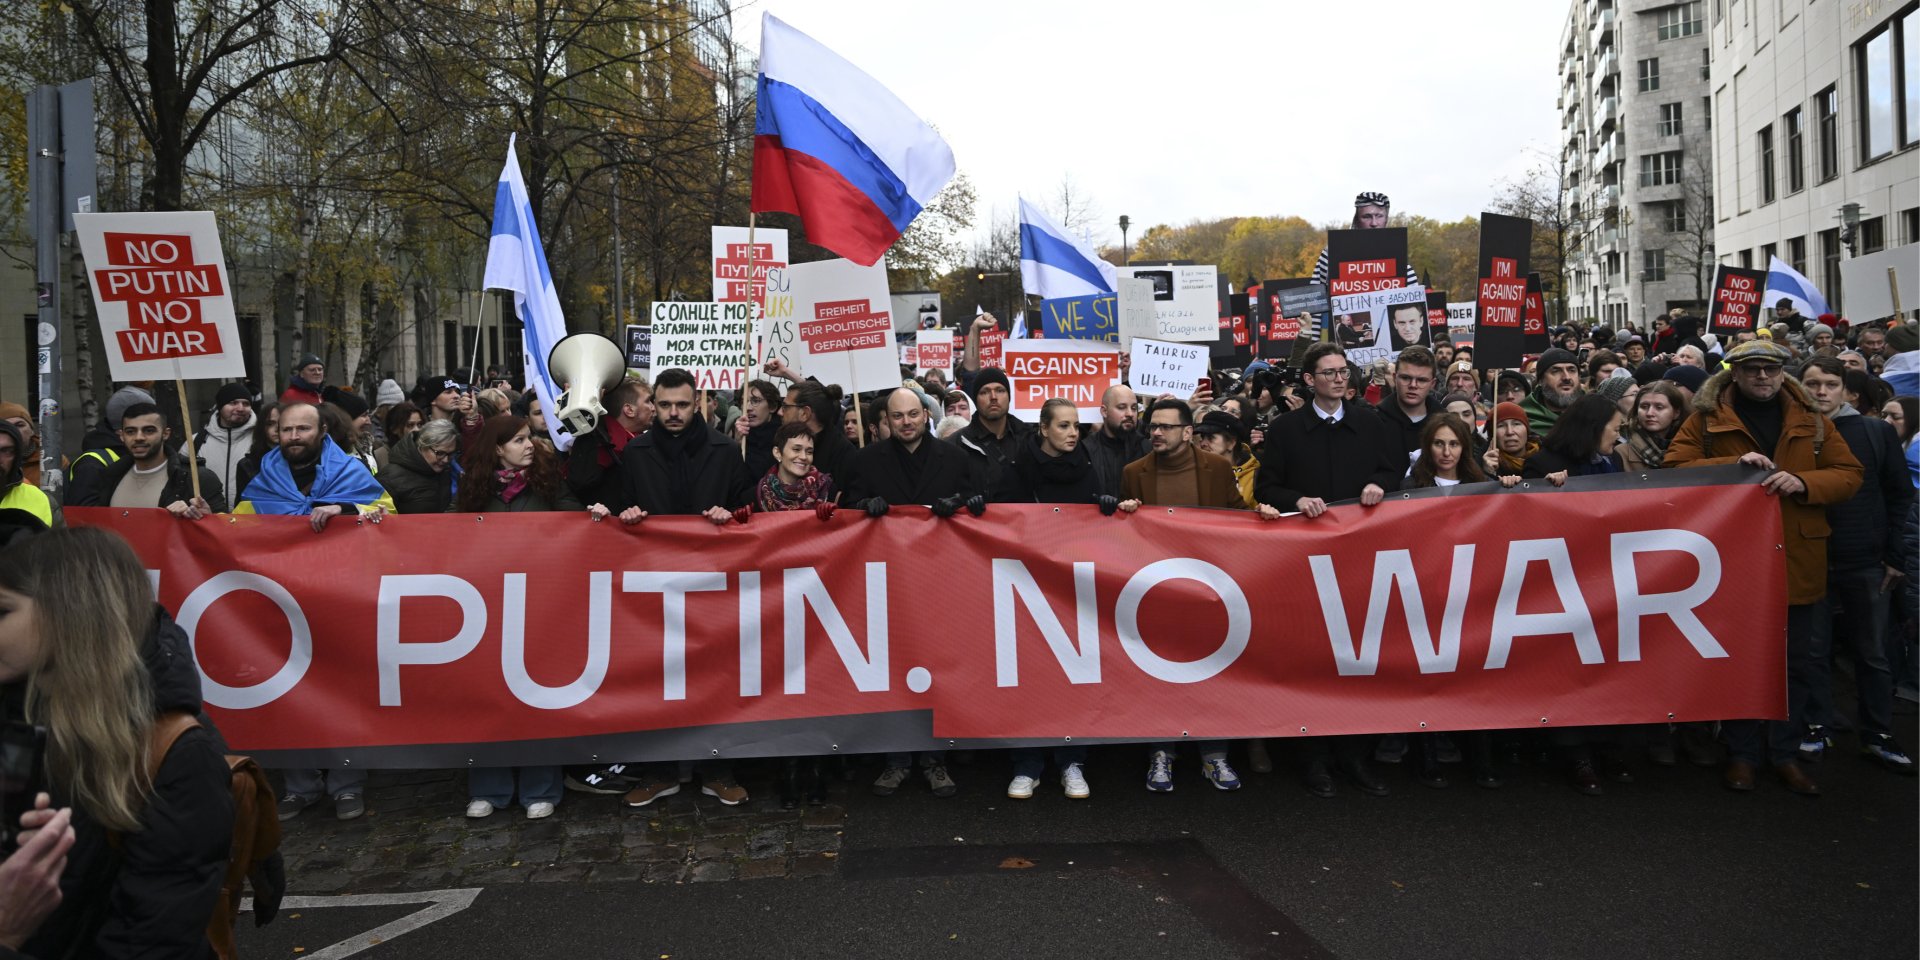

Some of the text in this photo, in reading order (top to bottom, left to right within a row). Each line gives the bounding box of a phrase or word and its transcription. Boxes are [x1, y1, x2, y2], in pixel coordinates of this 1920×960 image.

[124, 240, 179, 264] NO
[736, 245, 766, 259] НЕТ
[721, 264, 782, 278] ПУТИН
[1348, 262, 1386, 275] PUTIN
[1496, 261, 1511, 277] I'M
[108, 270, 210, 295] PUTIN
[735, 283, 765, 296] НЕТ
[1333, 279, 1400, 293] MUSS VOR
[1731, 278, 1750, 290] NO
[1481, 283, 1524, 301] AGAINST
[1720, 289, 1756, 304] PUTIN
[820, 304, 866, 317] FREIHEIT
[1331, 294, 1371, 312] PUTIN
[1727, 303, 1746, 314] NO
[139, 301, 192, 325] NO
[655, 303, 718, 321] СОЛНЦЕ
[1051, 301, 1086, 333] WE
[1486, 306, 1516, 322] PUTIN!
[801, 317, 889, 337] FÜR POLITISCHE
[1719, 313, 1747, 327] WAR
[652, 323, 699, 335] ВЗГЛЯНИ
[702, 323, 718, 335] НА
[127, 330, 207, 355] WAR
[667, 338, 752, 352] МОЯ СТРАНА
[813, 334, 881, 351] GEFANGENE
[922, 345, 947, 353] PUTIN
[1144, 344, 1197, 359] TAURUS
[657, 354, 757, 367] ПРЕВРАТИЛАСЬ
[1012, 357, 1112, 375] AGAINST
[1162, 361, 1184, 371] for
[1141, 373, 1195, 391] Ukraine
[1029, 384, 1094, 402] PUTIN
[146, 529, 1730, 709] O PUTIN. NO WAR
